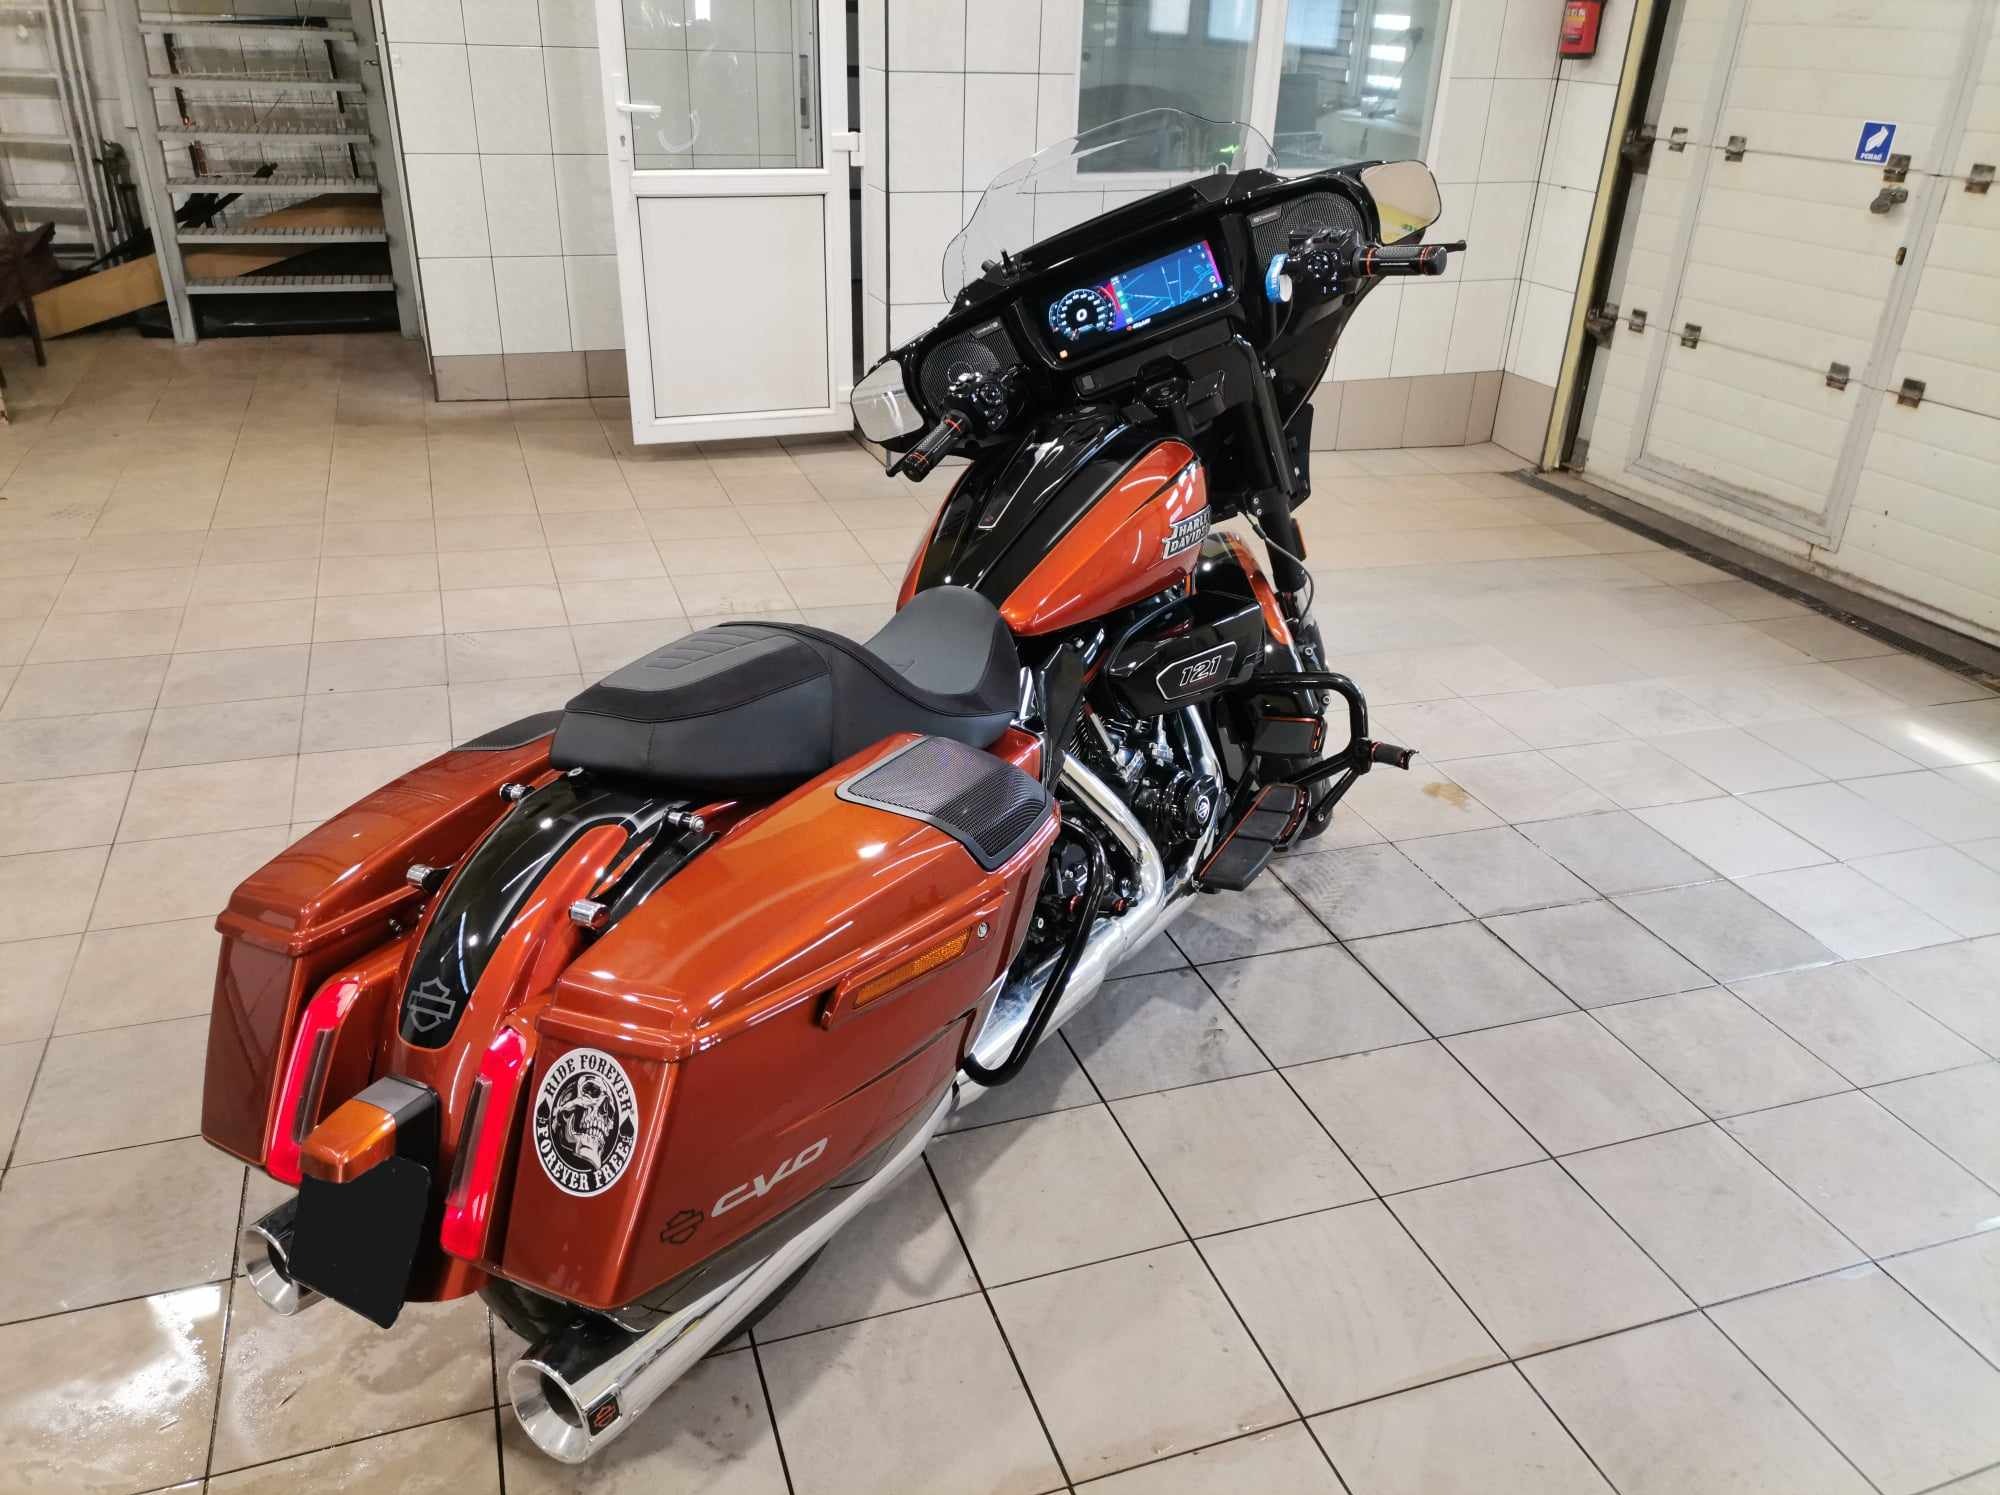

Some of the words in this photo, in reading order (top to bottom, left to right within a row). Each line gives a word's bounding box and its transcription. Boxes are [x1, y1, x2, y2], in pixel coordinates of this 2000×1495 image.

[1179, 654, 1222, 687] 121
[543, 1058, 576, 1097] RIDE
[578, 1054, 633, 1112] FOREVER
[537, 1125, 590, 1191] FOREVER
[594, 1141, 631, 1189] FREE
